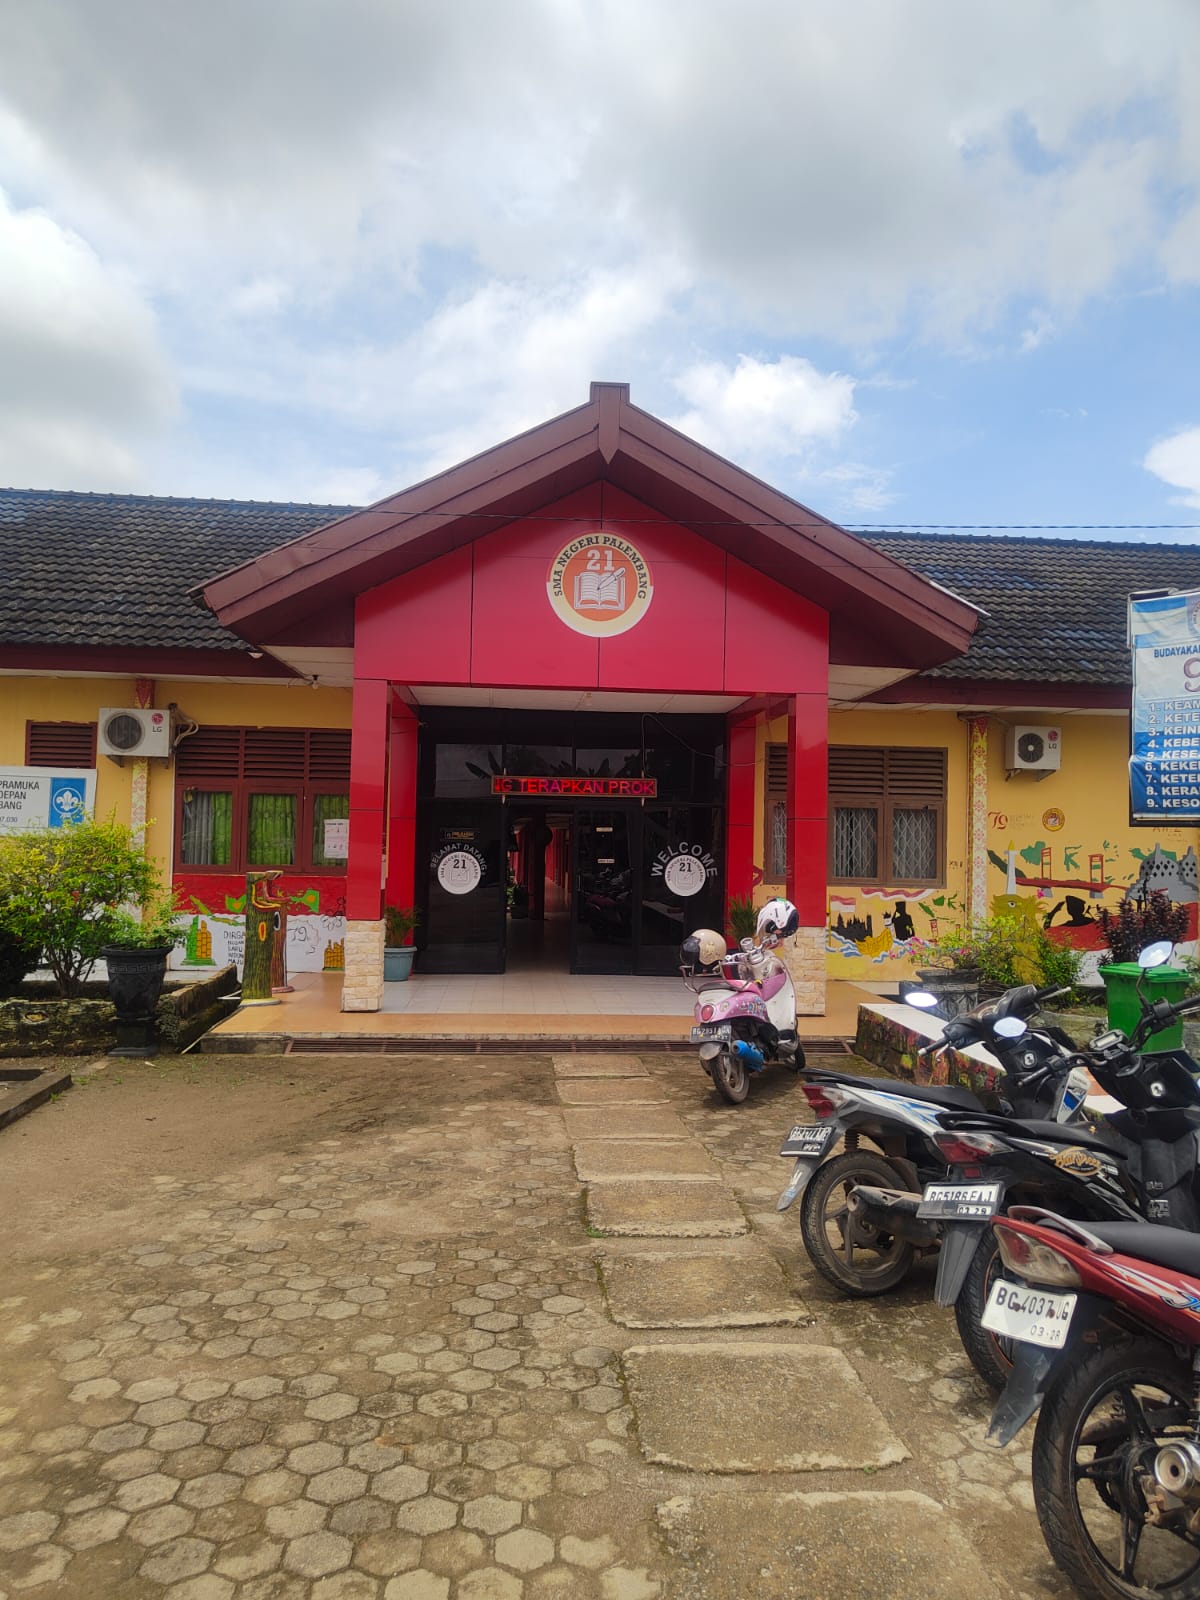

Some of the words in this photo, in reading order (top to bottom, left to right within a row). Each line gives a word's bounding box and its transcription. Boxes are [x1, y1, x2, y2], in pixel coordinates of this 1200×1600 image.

[557, 536, 600, 568] NEGERI
[586, 549, 615, 571] 21
[603, 536, 648, 600] PALEMBANG
[553, 570, 563, 597] SMA
[1154, 645, 1200, 658] BUDAYAKA
[1150, 703, 1160, 712] 1.
[1148, 715, 1160, 724] 2.
[1148, 727, 1160, 737] 3.
[1164, 726, 1200, 736] KEIN
[1147, 739, 1159, 748] 4.
[1147, 751, 1158, 760] 5.
[1144, 762, 1156, 771] 6.
[1146, 774, 1157, 783] 7.
[1160, 773, 1200, 783] KETE
[518, 778, 605, 794] TERAPKAN
[607, 780, 655, 794] PROK
[1146, 786, 1158, 796] 8.
[1146, 799, 1159, 808] 9.
[987, 811, 1009, 830] 79
[431, 843, 462, 869] SELAMAT
[463, 843, 488, 872] DATANG
[650, 841, 718, 878] WELCOME
[453, 859, 467, 870] 21
[679, 863, 692, 873] 21
[996, 1287, 1019, 1311] BG
[1020, 1295, 1055, 1319] 4037
